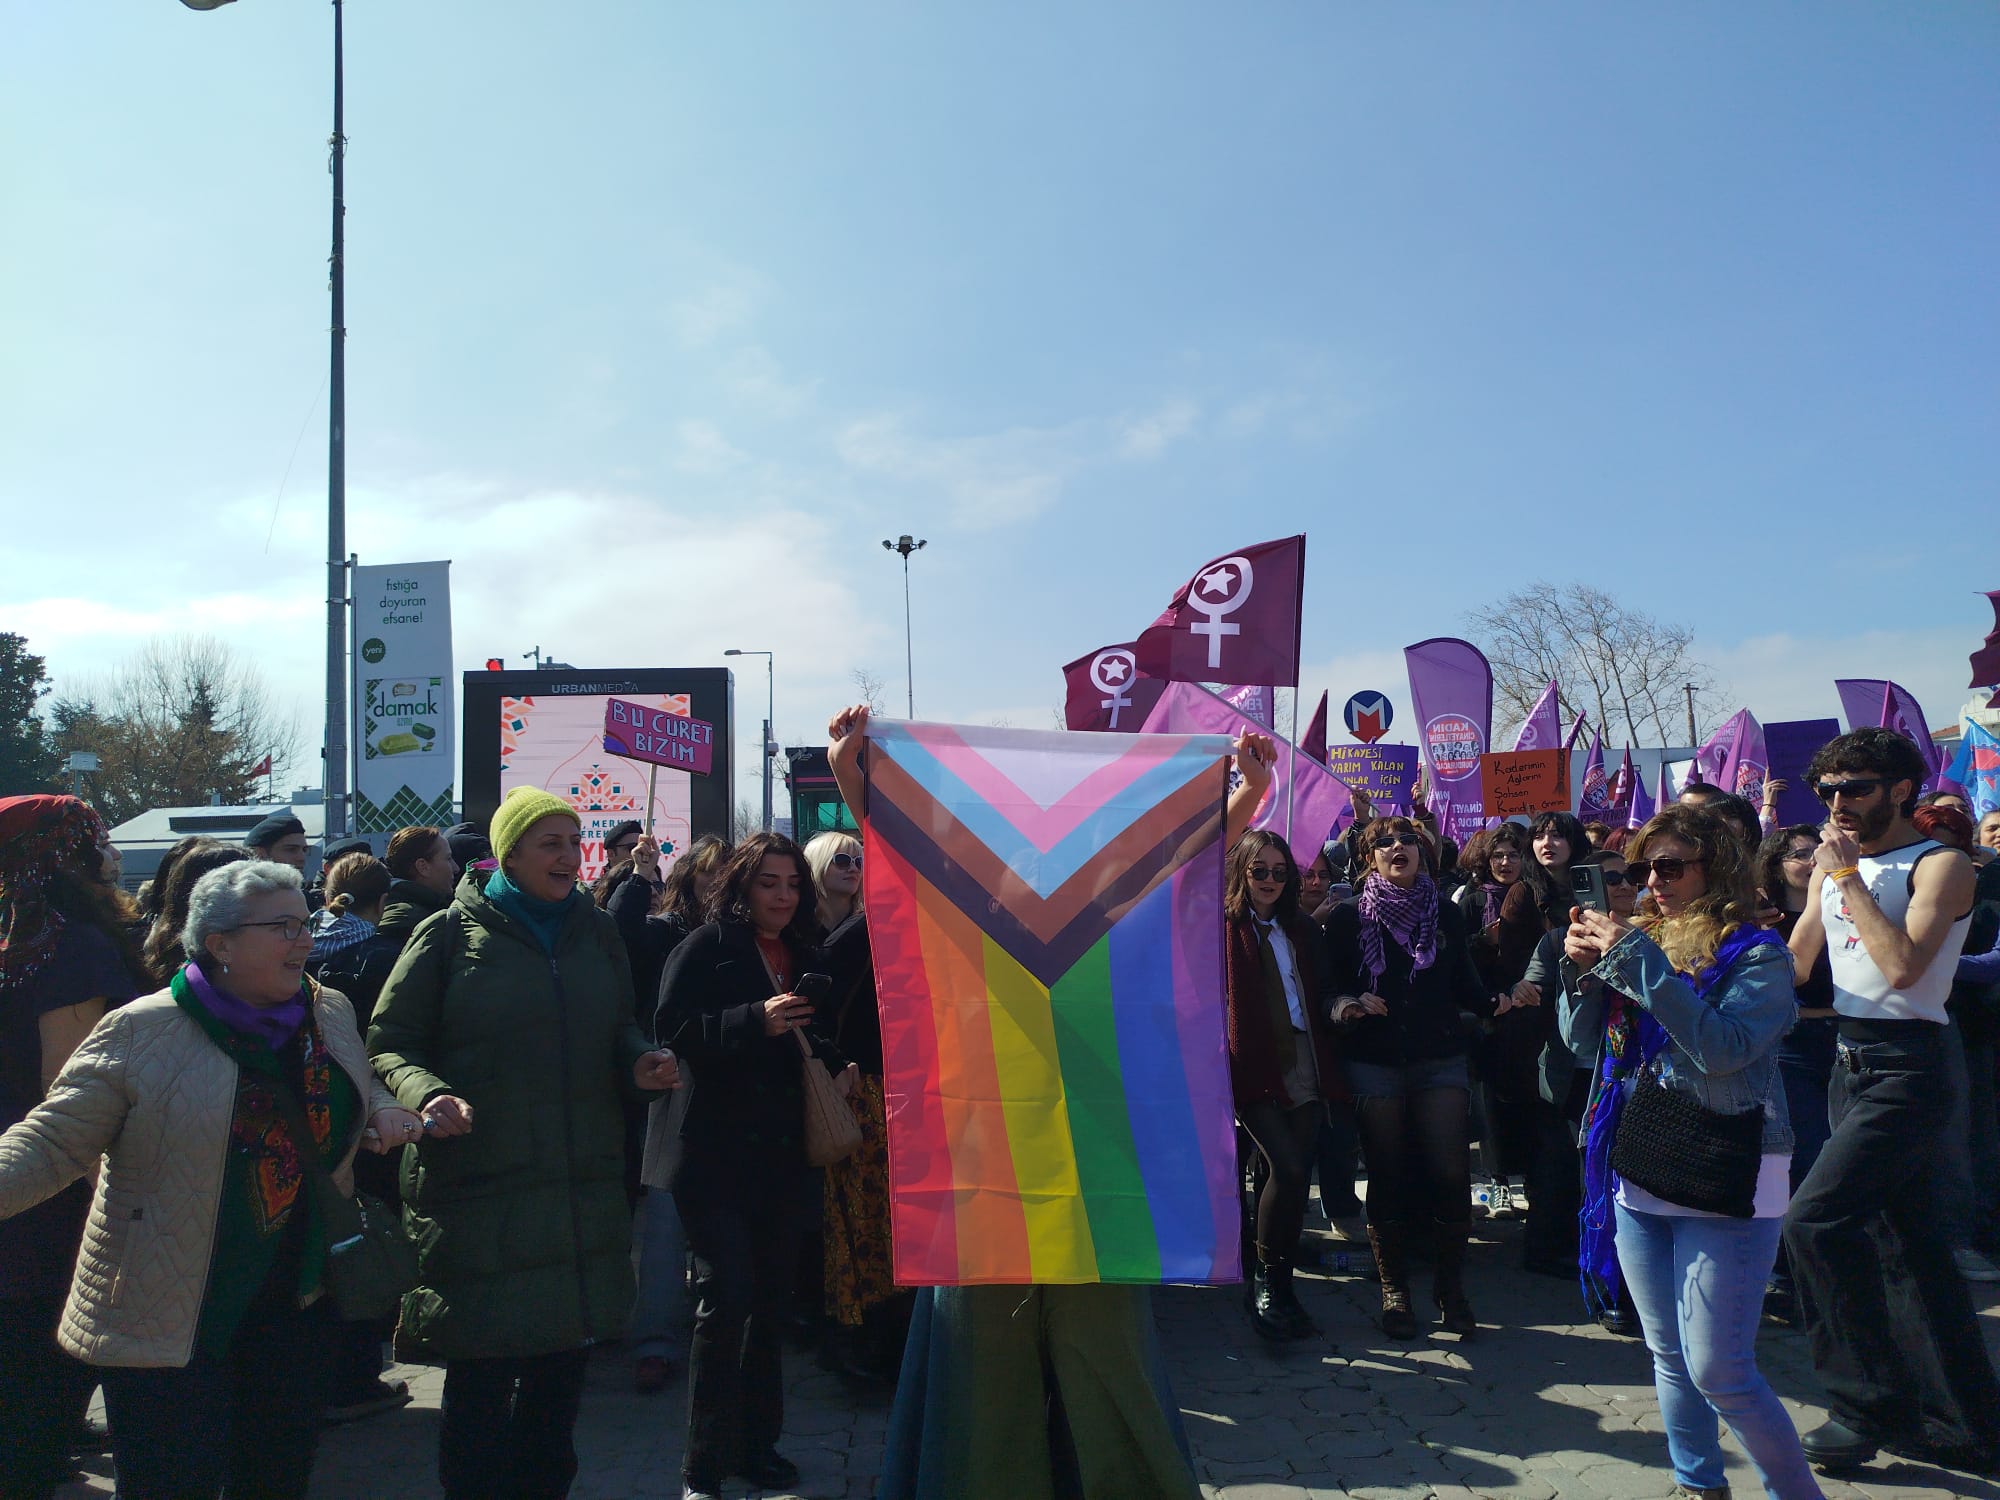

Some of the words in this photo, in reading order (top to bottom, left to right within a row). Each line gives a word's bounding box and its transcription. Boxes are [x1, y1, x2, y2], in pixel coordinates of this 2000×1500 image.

[379, 595, 426, 611] doyuran
[382, 611, 423, 625] efsane!
[365, 644, 383, 657] yeni
[373, 689, 438, 717] damak
[612, 701, 644, 728] BU
[634, 731, 695, 763] BİZİM
[1330, 746, 1383, 760] HİKAYESİ
[1330, 761, 1361, 774] YARIM
[1371, 760, 1404, 772] KALAN
[1380, 774, 1401, 787] İÇİN
[1365, 788, 1393, 799] AYIZ
